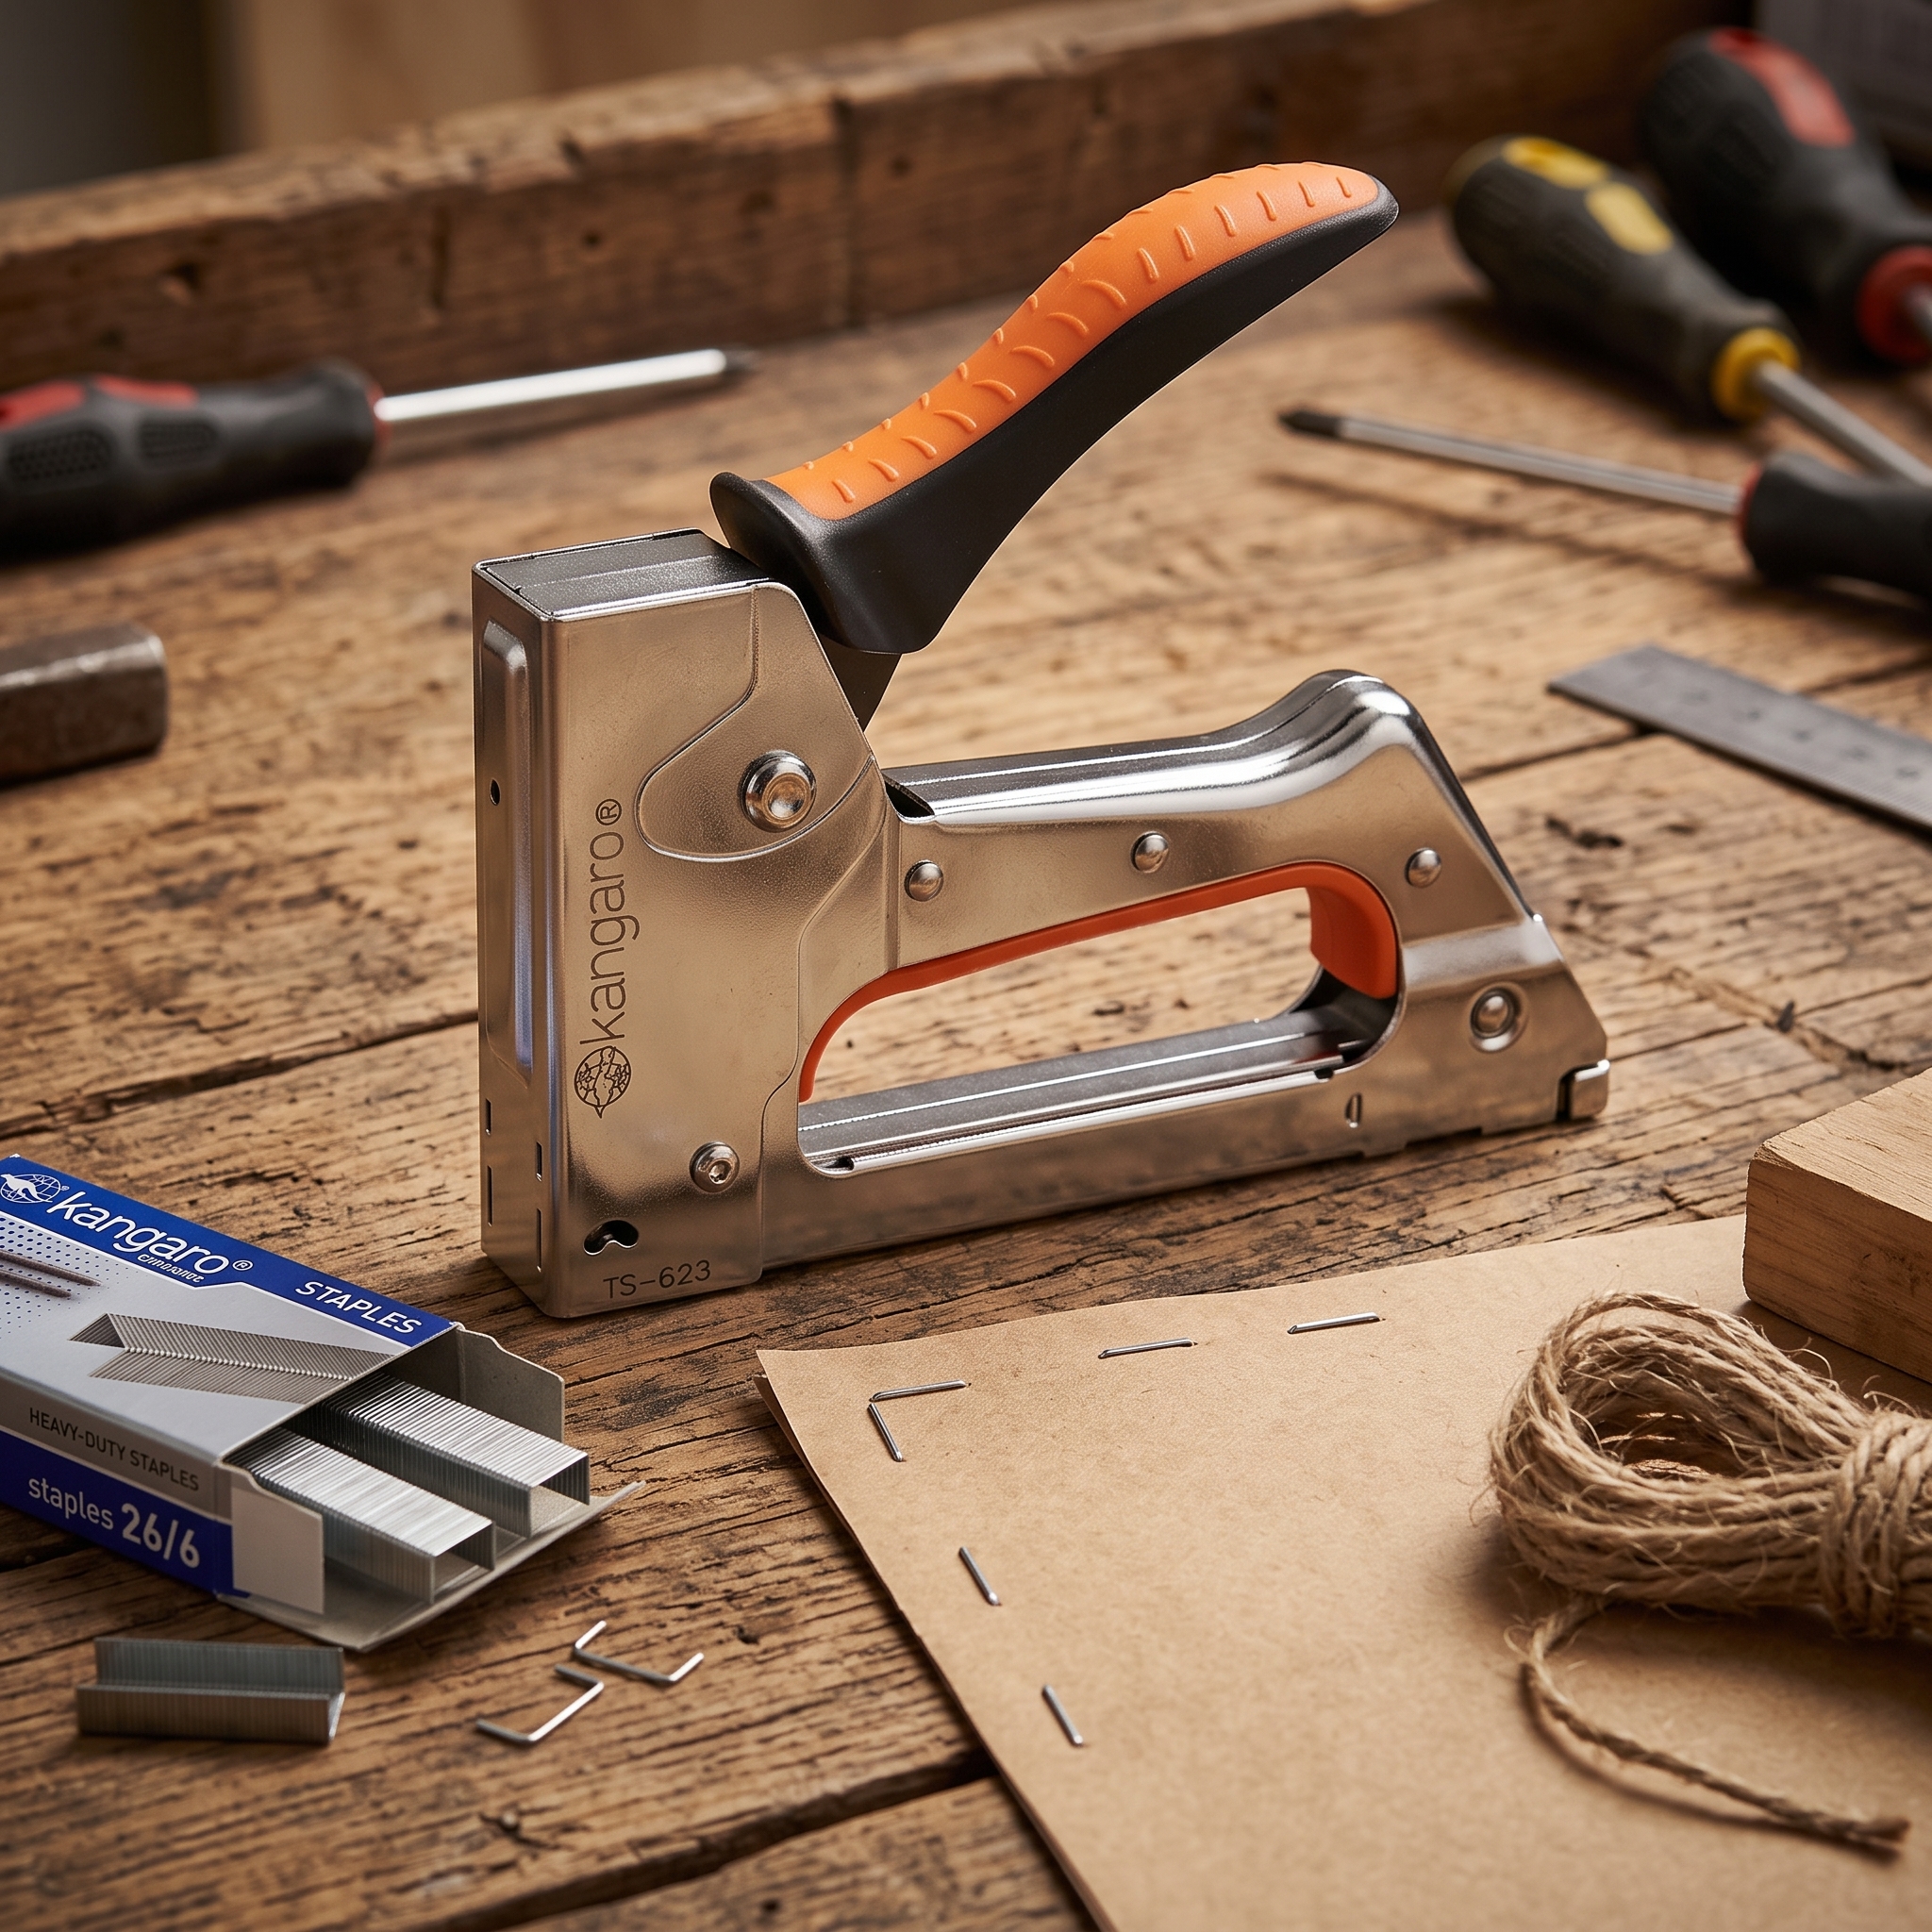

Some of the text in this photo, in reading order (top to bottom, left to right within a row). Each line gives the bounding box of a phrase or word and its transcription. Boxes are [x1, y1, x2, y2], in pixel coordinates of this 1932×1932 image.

[294, 1281, 423, 1334] STAPLES
[602, 1259, 711, 1299] TS-623
[29, 1407, 200, 1491] HEAVY-DUTY STAPLES
[28, 1477, 201, 1569] staples 26/6
